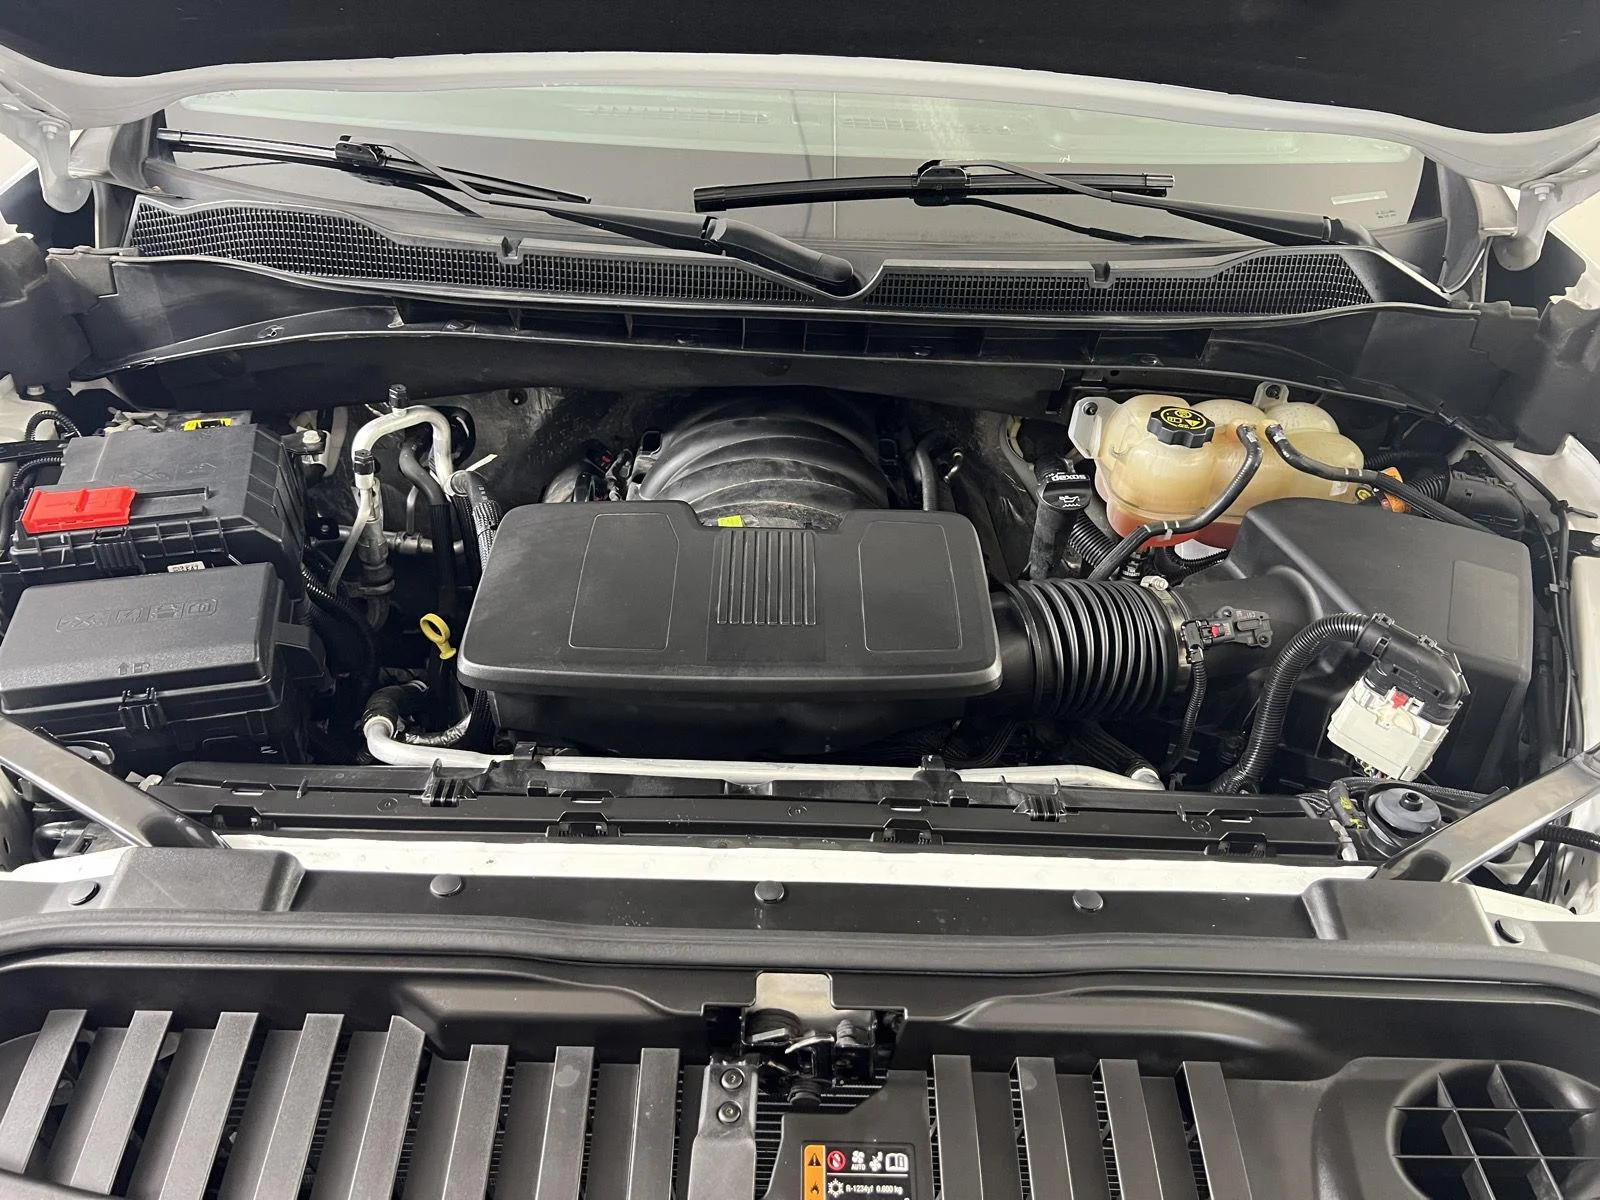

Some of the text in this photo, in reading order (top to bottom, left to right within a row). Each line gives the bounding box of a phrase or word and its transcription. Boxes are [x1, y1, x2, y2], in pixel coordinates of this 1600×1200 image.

[1051, 472, 1086, 481] dexos
[851, 1163, 866, 1171] AUTO
[845, 1184, 874, 1194] R-1234yf
[894, 1185, 903, 1195] kg
